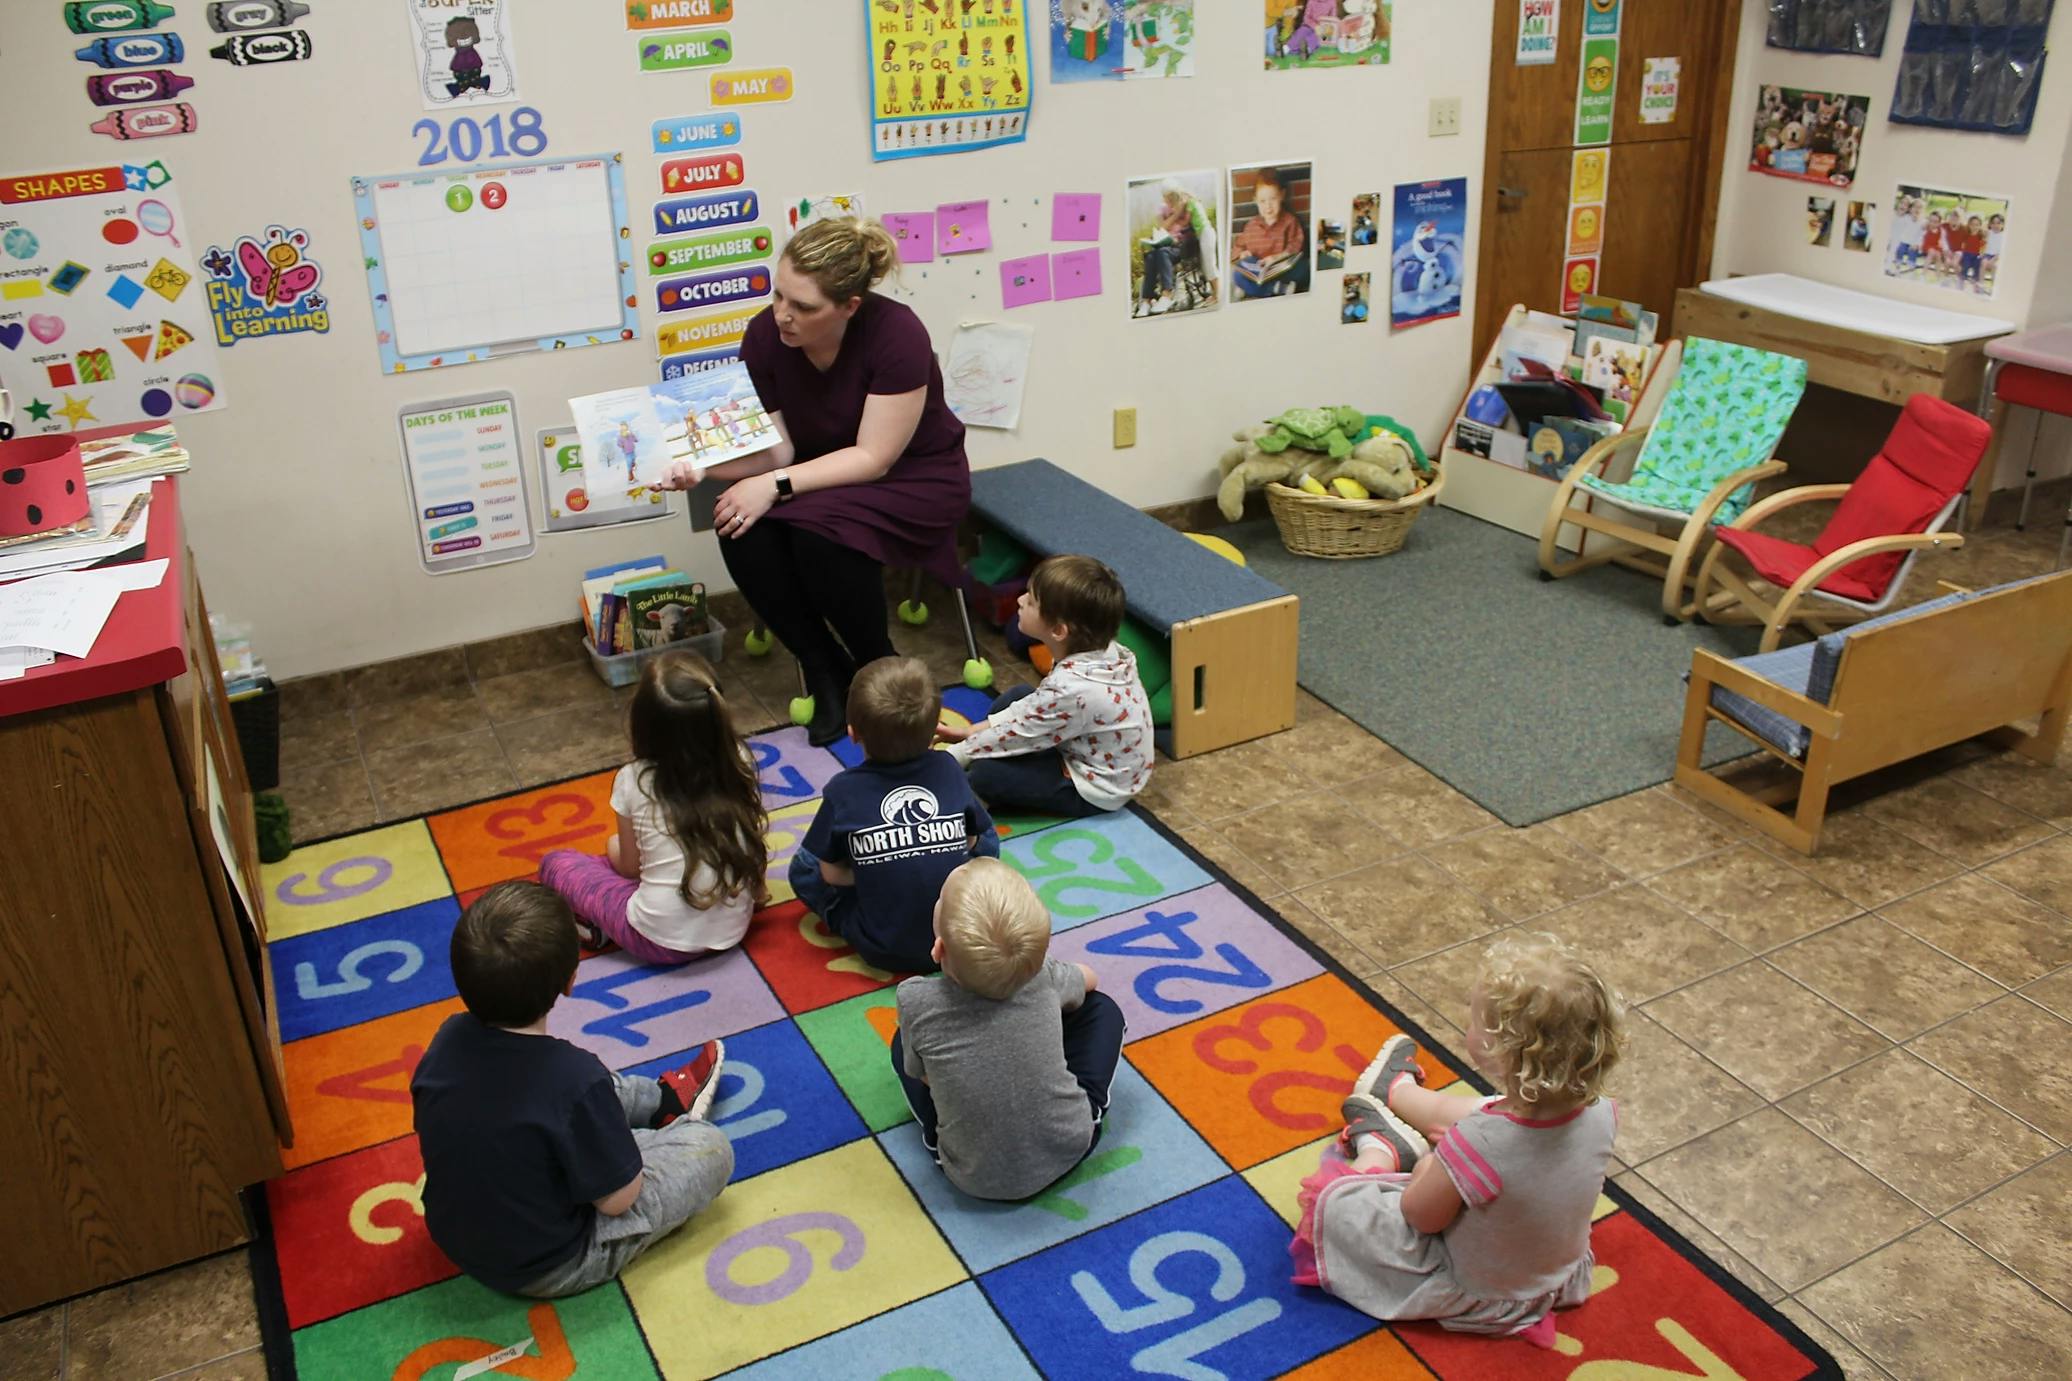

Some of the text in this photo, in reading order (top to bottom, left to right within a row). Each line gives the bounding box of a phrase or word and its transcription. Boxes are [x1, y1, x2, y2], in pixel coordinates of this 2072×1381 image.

[91, 8, 133, 24] green
[651, 0, 710, 19] MARCH
[880, 22, 898, 33] Hh
[941, 18, 956, 30] Kk
[976, 17, 998, 28] Mm
[1000, 15, 1017, 27] Nn
[1523, 18, 1544, 35] AM
[123, 44, 157, 57] blue
[251, 41, 289, 55] black
[663, 41, 710, 61] APRIL
[881, 61, 901, 73] Oo
[909, 60, 924, 73] Pp
[930, 58, 952, 73] Qq
[981, 55, 995, 66] Ss
[113, 81, 154, 97] purple
[732, 78, 769, 96] MAY
[883, 103, 901, 115] Uu
[909, 101, 925, 112] Vv
[929, 99, 954, 111] Ww
[958, 98, 974, 109] Xx
[1005, 95, 1020, 106] Zz
[136, 114, 171, 130] pink
[412, 107, 548, 166] 2018
[676, 124, 718, 143] JUNE
[683, 164, 721, 184] JULY
[15, 173, 107, 200] SHAPES
[455, 189, 499, 205] 1 2
[1408, 192, 1416, 201] A
[104, 206, 126, 215] oval
[676, 201, 739, 224] AUGUST
[668, 238, 752, 265] SEPTEMBER
[0, 265, 49, 278] rectangle
[105, 260, 148, 273] diamond
[206, 282, 244, 311] Fly
[680, 277, 749, 301] OCTOBER
[0, 311, 22, 321] eart
[226, 306, 264, 320] into
[113, 322, 152, 335] triangle
[214, 308, 328, 344] Learning
[677, 316, 751, 343] NOVEMBE
[31, 353, 67, 364] square
[143, 376, 170, 386] circle
[406, 404, 509, 428] DAYS OF THE WEEK
[42, 423, 62, 433] star
[477, 424, 503, 434] SUNDAY
[478, 441, 506, 452] MONDAY
[481, 460, 509, 471] TUESDAY
[480, 477, 518, 489] WEDNESDAY
[484, 495, 516, 506] THURSDAY
[492, 512, 513, 523] FRIDAY
[490, 529, 521, 541] SATURDAY
[636, 591, 698, 611] The Little Lamb
[853, 818, 967, 855] NORTH SHORE
[295, 938, 424, 1000] 5
[1085, 910, 1273, 1015] 24
[1192, 1002, 1370, 1131] 23
[1070, 1230, 1283, 1381] 15
